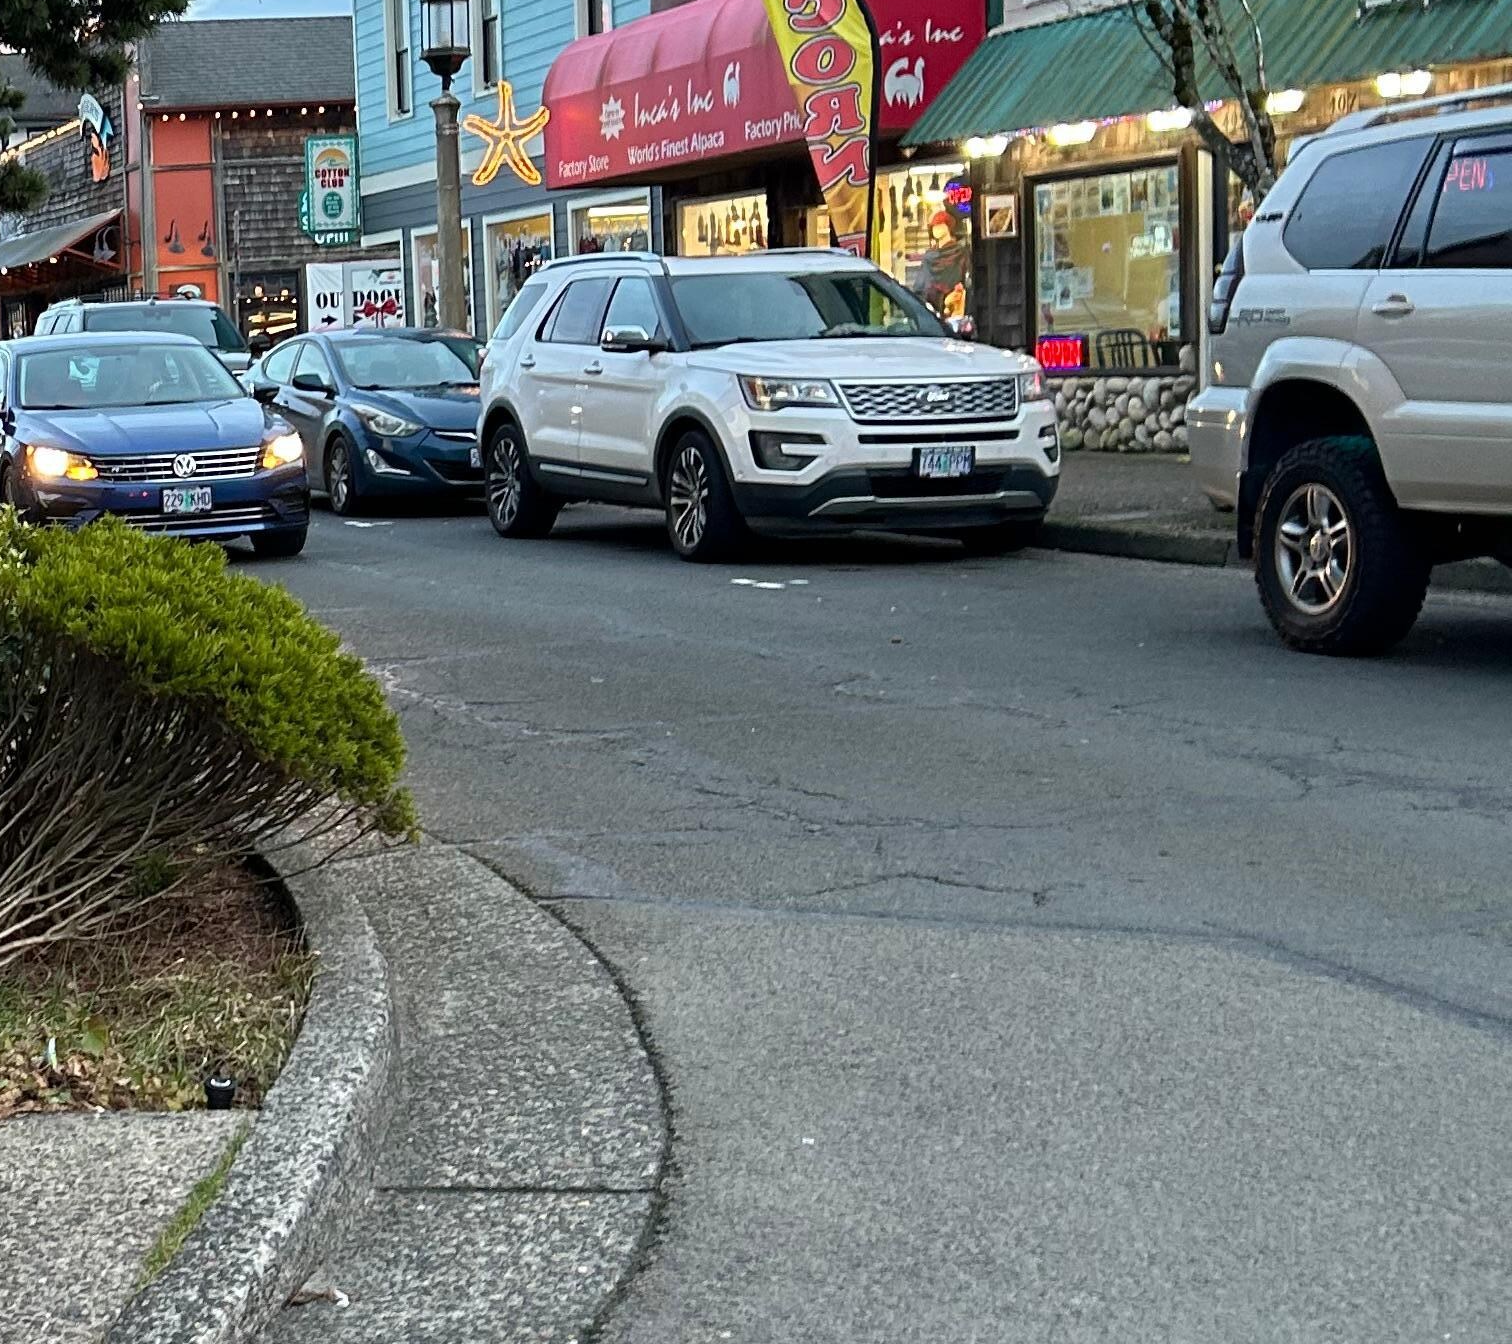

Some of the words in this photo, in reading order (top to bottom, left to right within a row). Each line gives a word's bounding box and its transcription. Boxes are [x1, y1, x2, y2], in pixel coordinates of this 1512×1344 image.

[925, 18, 965, 44] Inc
[634, 85, 681, 129] Inca's
[687, 78, 715, 116] Inc
[744, 117, 783, 142] Factory
[783, 109, 804, 134] Pric
[627, 144, 661, 166] World's
[661, 139, 689, 161] Finest
[690, 130, 725, 154] Alpaca
[315, 168, 350, 179] COTTON
[558, 157, 588, 180] Factory
[588, 154, 610, 173] Store
